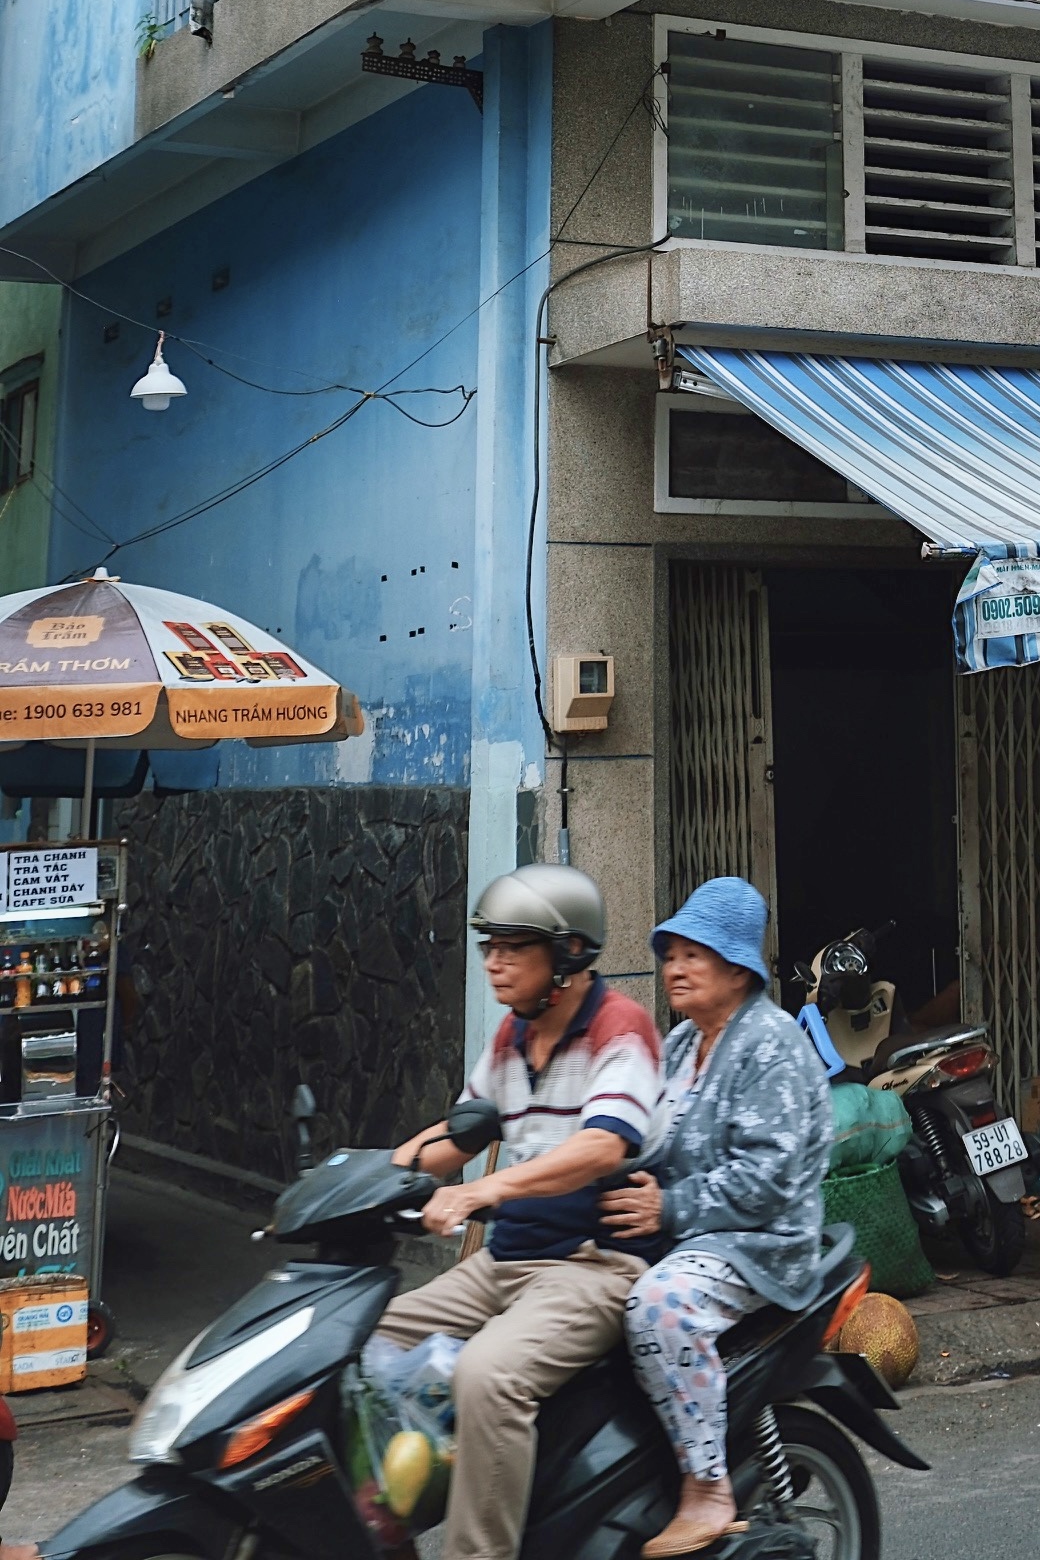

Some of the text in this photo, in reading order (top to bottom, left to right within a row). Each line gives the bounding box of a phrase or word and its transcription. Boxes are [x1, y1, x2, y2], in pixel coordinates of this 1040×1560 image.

[24, 704, 66, 720] 1900
[72, 702, 104, 718] 633
[110, 701, 142, 716] 981
[176, 709, 228, 724] NHANG
[276, 705, 328, 721] HƯƠNG
[44, 851, 86, 862] CHANH
[13, 876, 40, 886] CAM
[13, 886, 56, 897] CHANH
[13, 897, 45, 907] CAFE
[972, 1124, 1010, 1151] 59-U1
[974, 1140, 1023, 1172] 788.28
[33, 1219, 80, 1258] Chất
